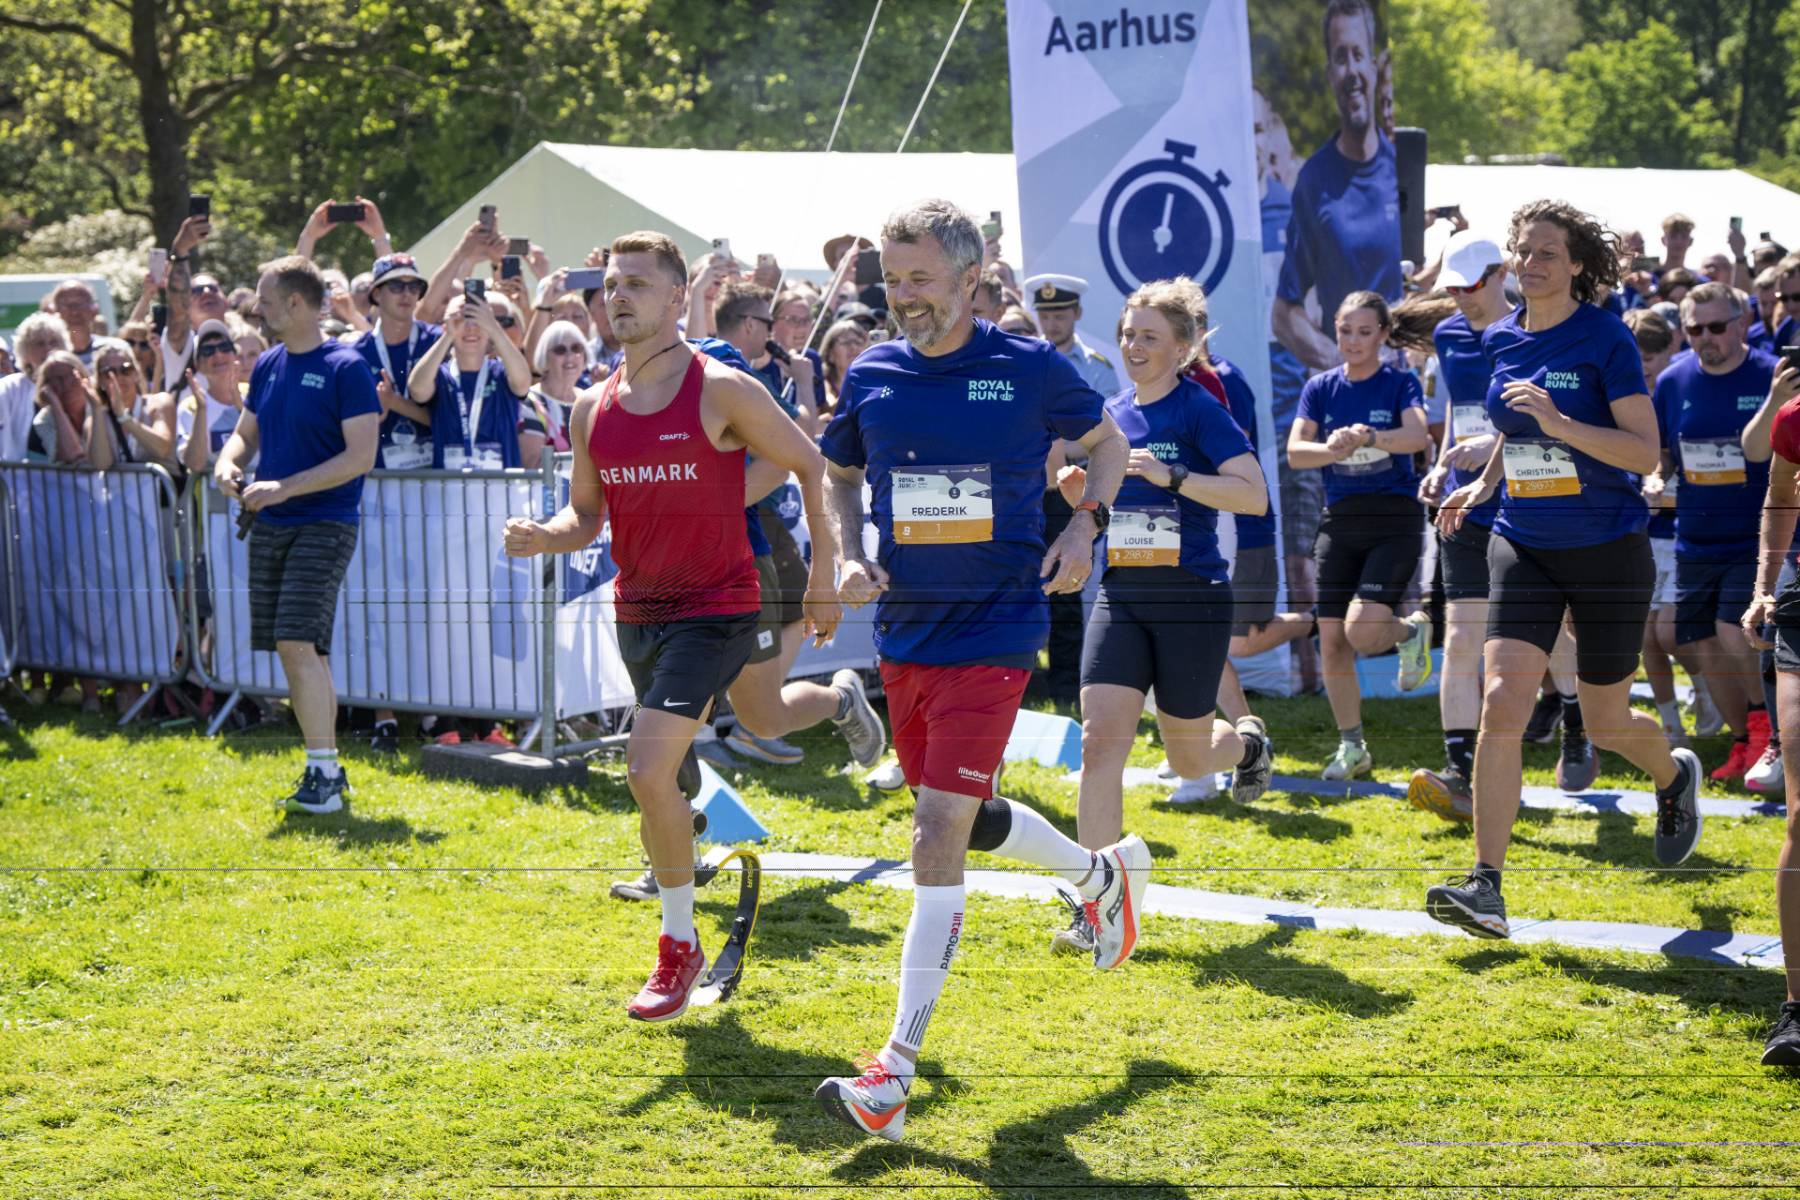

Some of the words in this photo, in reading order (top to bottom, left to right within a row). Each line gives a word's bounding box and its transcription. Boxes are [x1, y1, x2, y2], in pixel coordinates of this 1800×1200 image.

[1044, 8, 1197, 56] Aarhus
[1546, 371, 1580, 381] ROYAL
[968, 380, 1014, 390] ROYAL
[1545, 381, 1567, 389] RUN
[968, 391, 997, 400] RUN
[1147, 443, 1179, 451] ROYAL
[600, 463, 698, 485] DENMARK
[1516, 468, 1561, 476] CHRISTINA
[912, 506, 968, 516] FREDERIK
[1124, 537, 1155, 545] LOUISE
